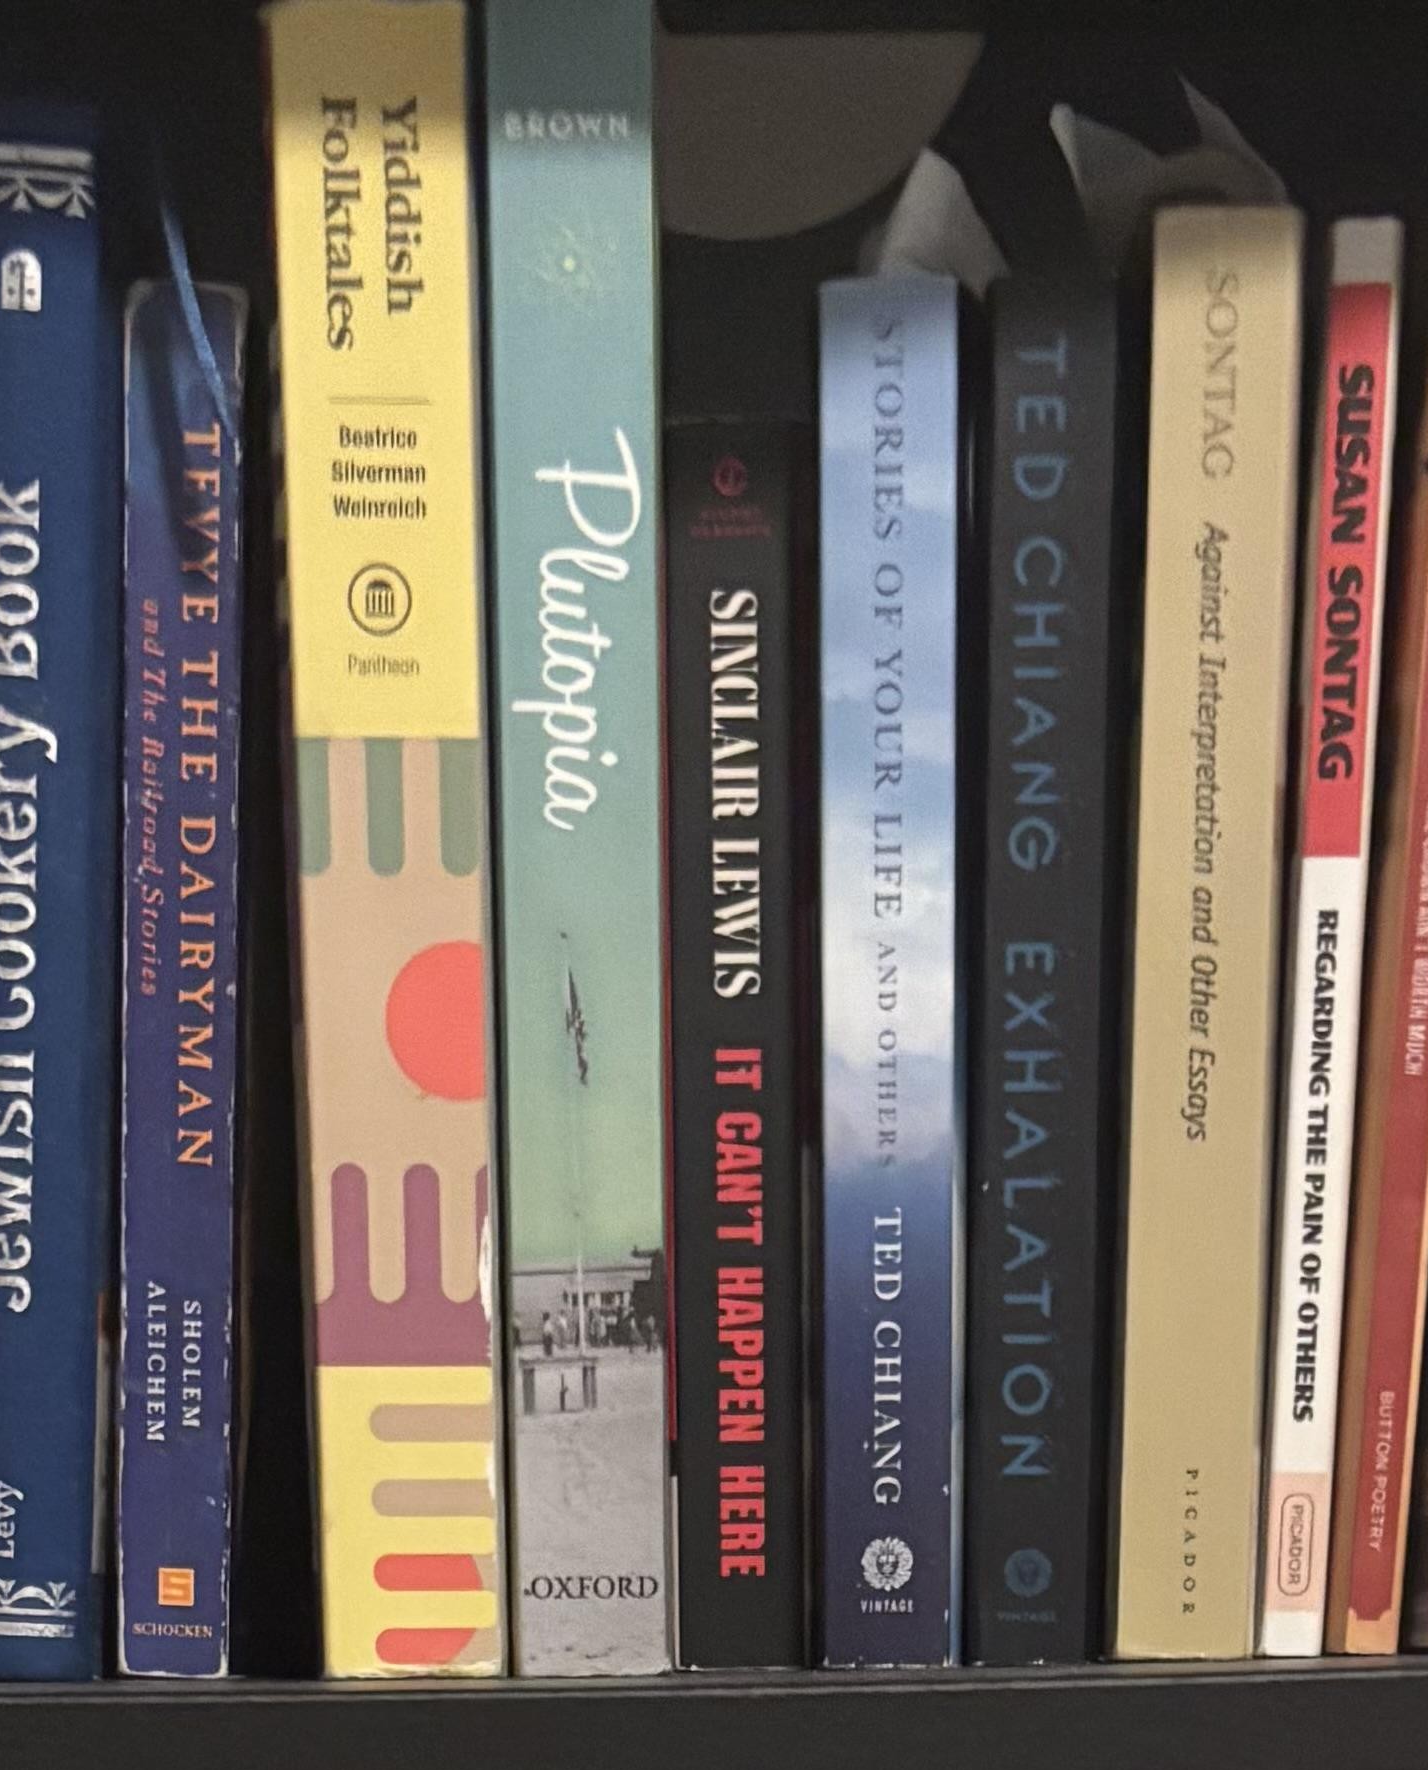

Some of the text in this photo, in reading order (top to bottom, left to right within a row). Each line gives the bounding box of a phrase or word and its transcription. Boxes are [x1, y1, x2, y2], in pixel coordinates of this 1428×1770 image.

[321, 97, 364, 352] Folktales
[381, 97, 424, 316] Yiddish
[512, 426, 641, 833] Plutopia
[710, 589, 759, 823] SINCLAIR
[1317, 364, 1374, 781] SUSAN SONTAG
[175, 424, 221, 1167] TEVYE THE DAIRYMAN
[711, 836, 761, 999] LEWIS
[1001, 338, 1067, 1479] TED CHIANG EXHALATION
[872, 1208, 903, 1507] TED CHIANG
[1182, 1468, 1199, 1615] PICADOR
